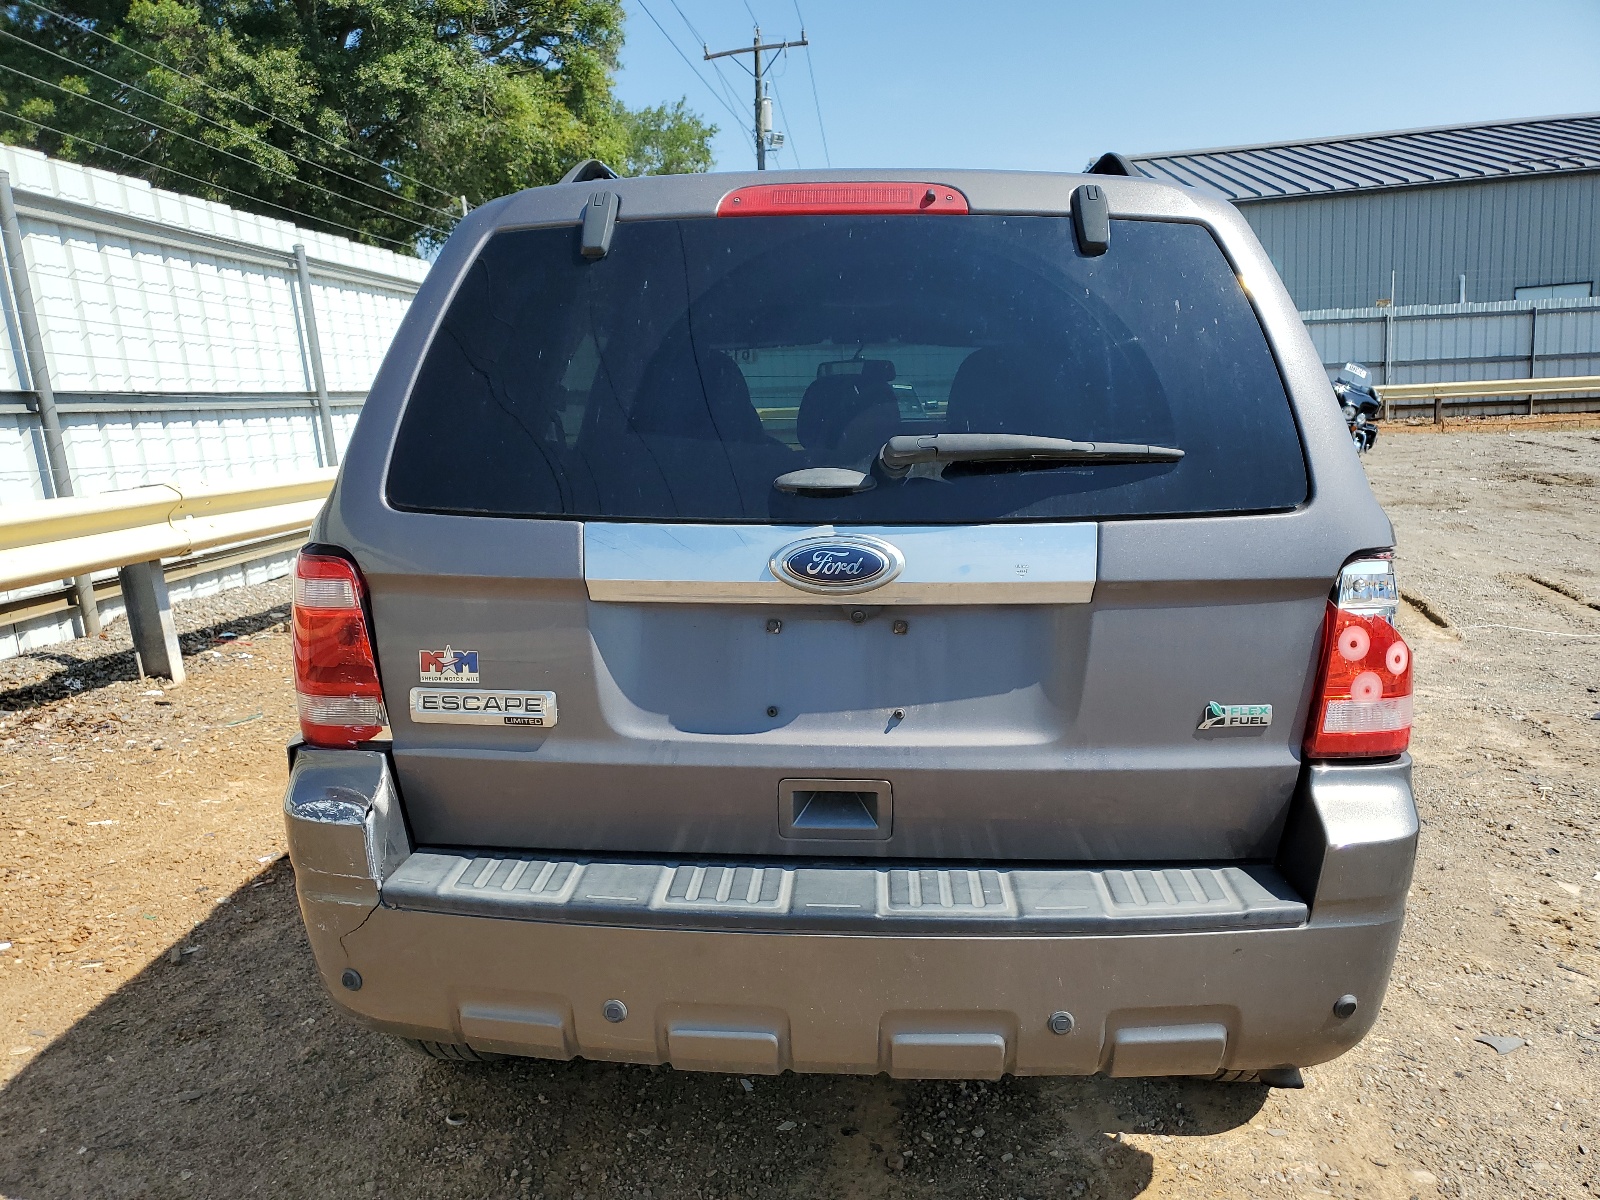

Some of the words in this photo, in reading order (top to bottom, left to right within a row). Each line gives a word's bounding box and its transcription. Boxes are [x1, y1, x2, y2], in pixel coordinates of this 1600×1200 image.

[806, 550, 864, 575] Ford
[422, 696, 543, 712] ESCAPE
[1230, 706, 1269, 715] FLEX
[505, 717, 542, 725] LIMITED
[1229, 716, 1268, 725] FUEL
